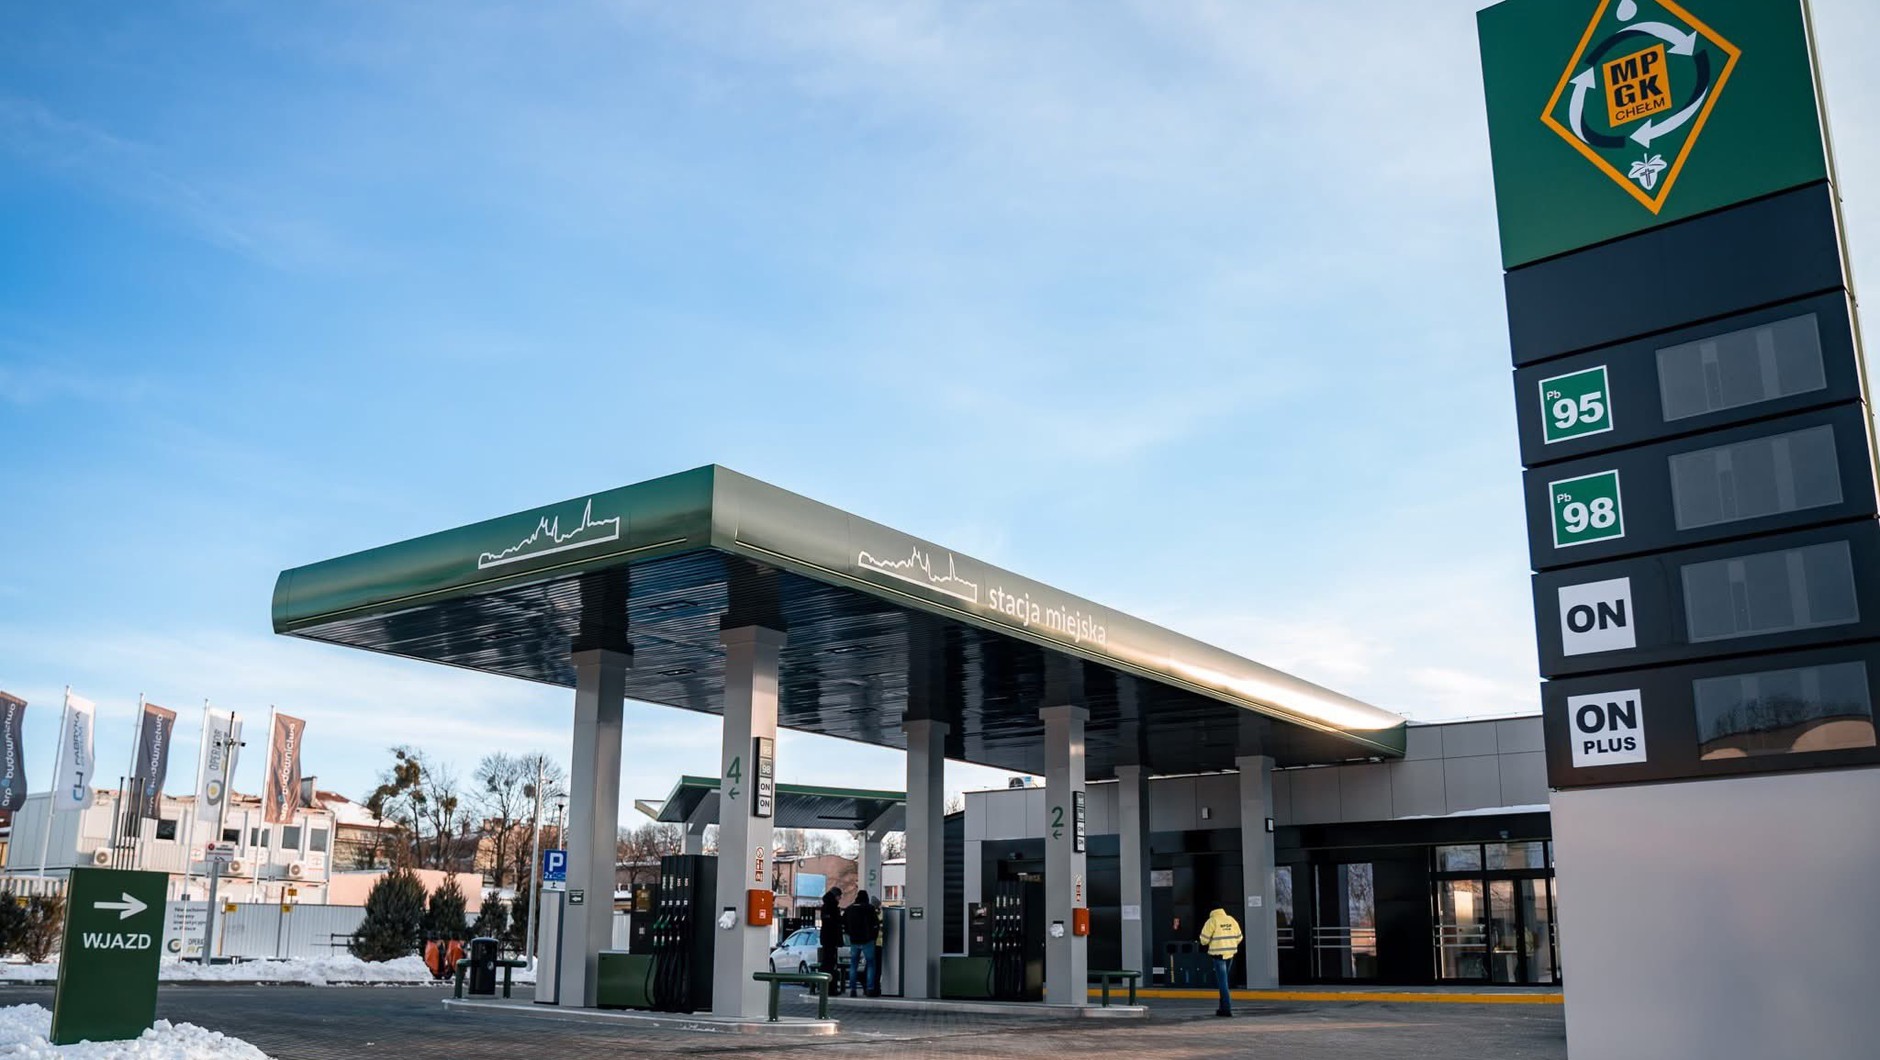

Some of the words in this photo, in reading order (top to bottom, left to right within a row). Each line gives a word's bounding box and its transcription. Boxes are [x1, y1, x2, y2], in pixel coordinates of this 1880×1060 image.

[1610, 51, 1659, 86] MP
[1614, 74, 1663, 108] GK
[1615, 97, 1665, 121] CHEŁM
[1546, 390, 1561, 401] Pb
[1552, 391, 1605, 429] 95
[1556, 492, 1572, 504] Pb
[1563, 496, 1616, 533] 98
[989, 586, 1040, 626] stacja
[1045, 605, 1107, 644] miejska
[1566, 598, 1627, 634] ON
[1575, 700, 1638, 734] ON
[5, 702, 16, 779] budownictwo
[1583, 736, 1637, 755] PLUS
[726, 756, 742, 784] 4
[2, 787, 13, 807] arp
[760, 783, 771, 791] ON
[759, 799, 770, 808] ON
[1051, 806, 1065, 828] 2
[549, 852, 564, 872] P
[868, 869, 877, 881] 5
[83, 932, 152, 950] WJAZD
